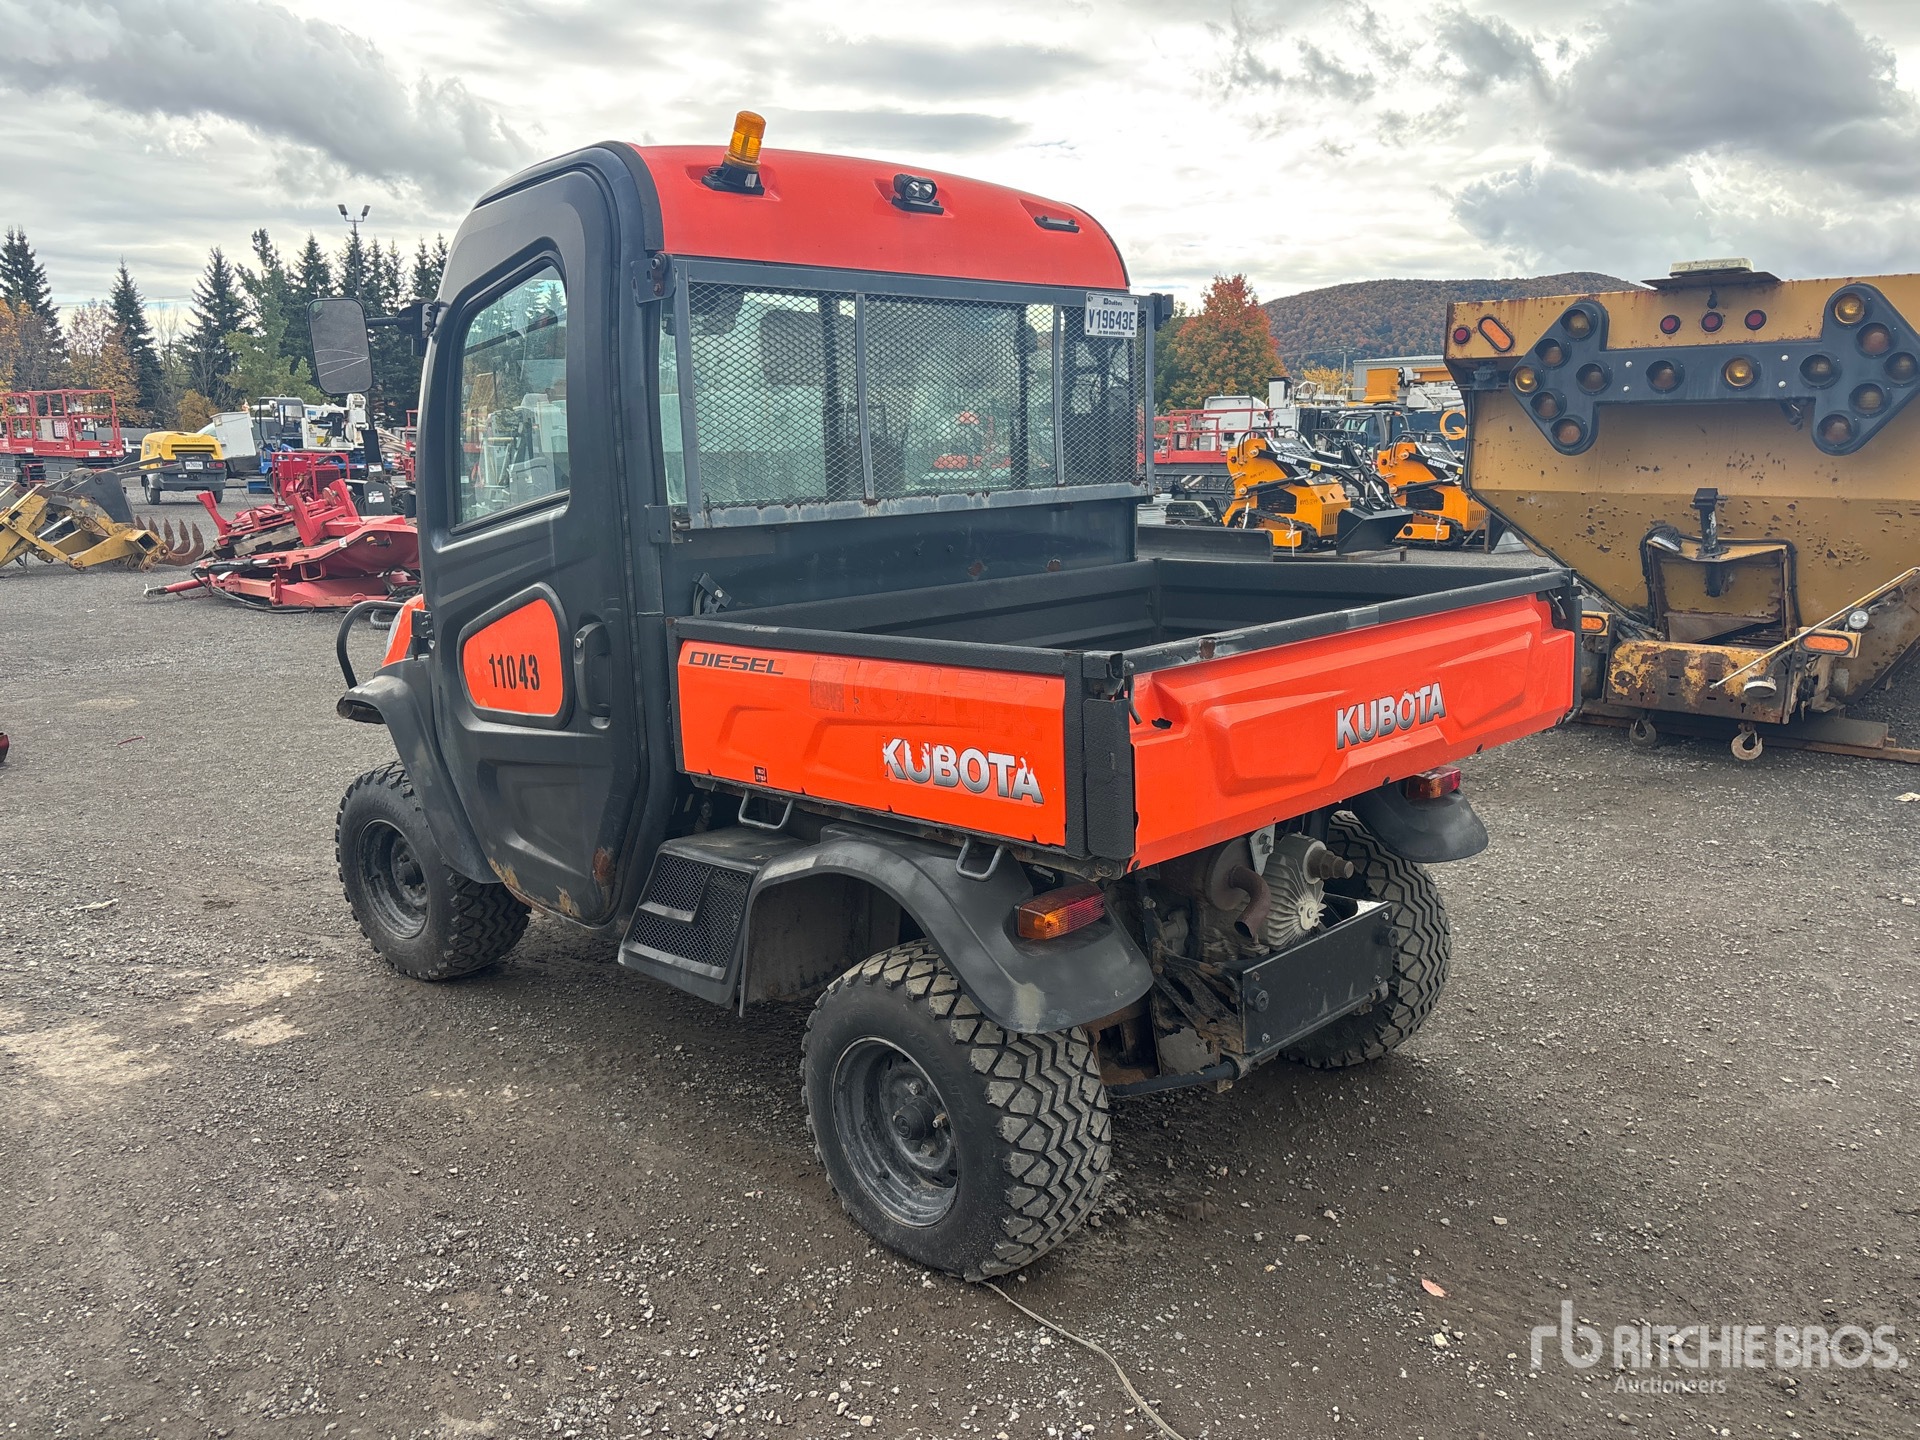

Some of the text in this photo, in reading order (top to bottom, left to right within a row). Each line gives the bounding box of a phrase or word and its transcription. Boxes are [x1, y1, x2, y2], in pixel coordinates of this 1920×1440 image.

[1089, 309, 1135, 330] V19643E
[489, 653, 540, 690] 11043
[688, 651, 784, 675] DIESEL
[1336, 681, 1446, 750] KUBOTA
[882, 736, 1044, 804] KUBOTA
